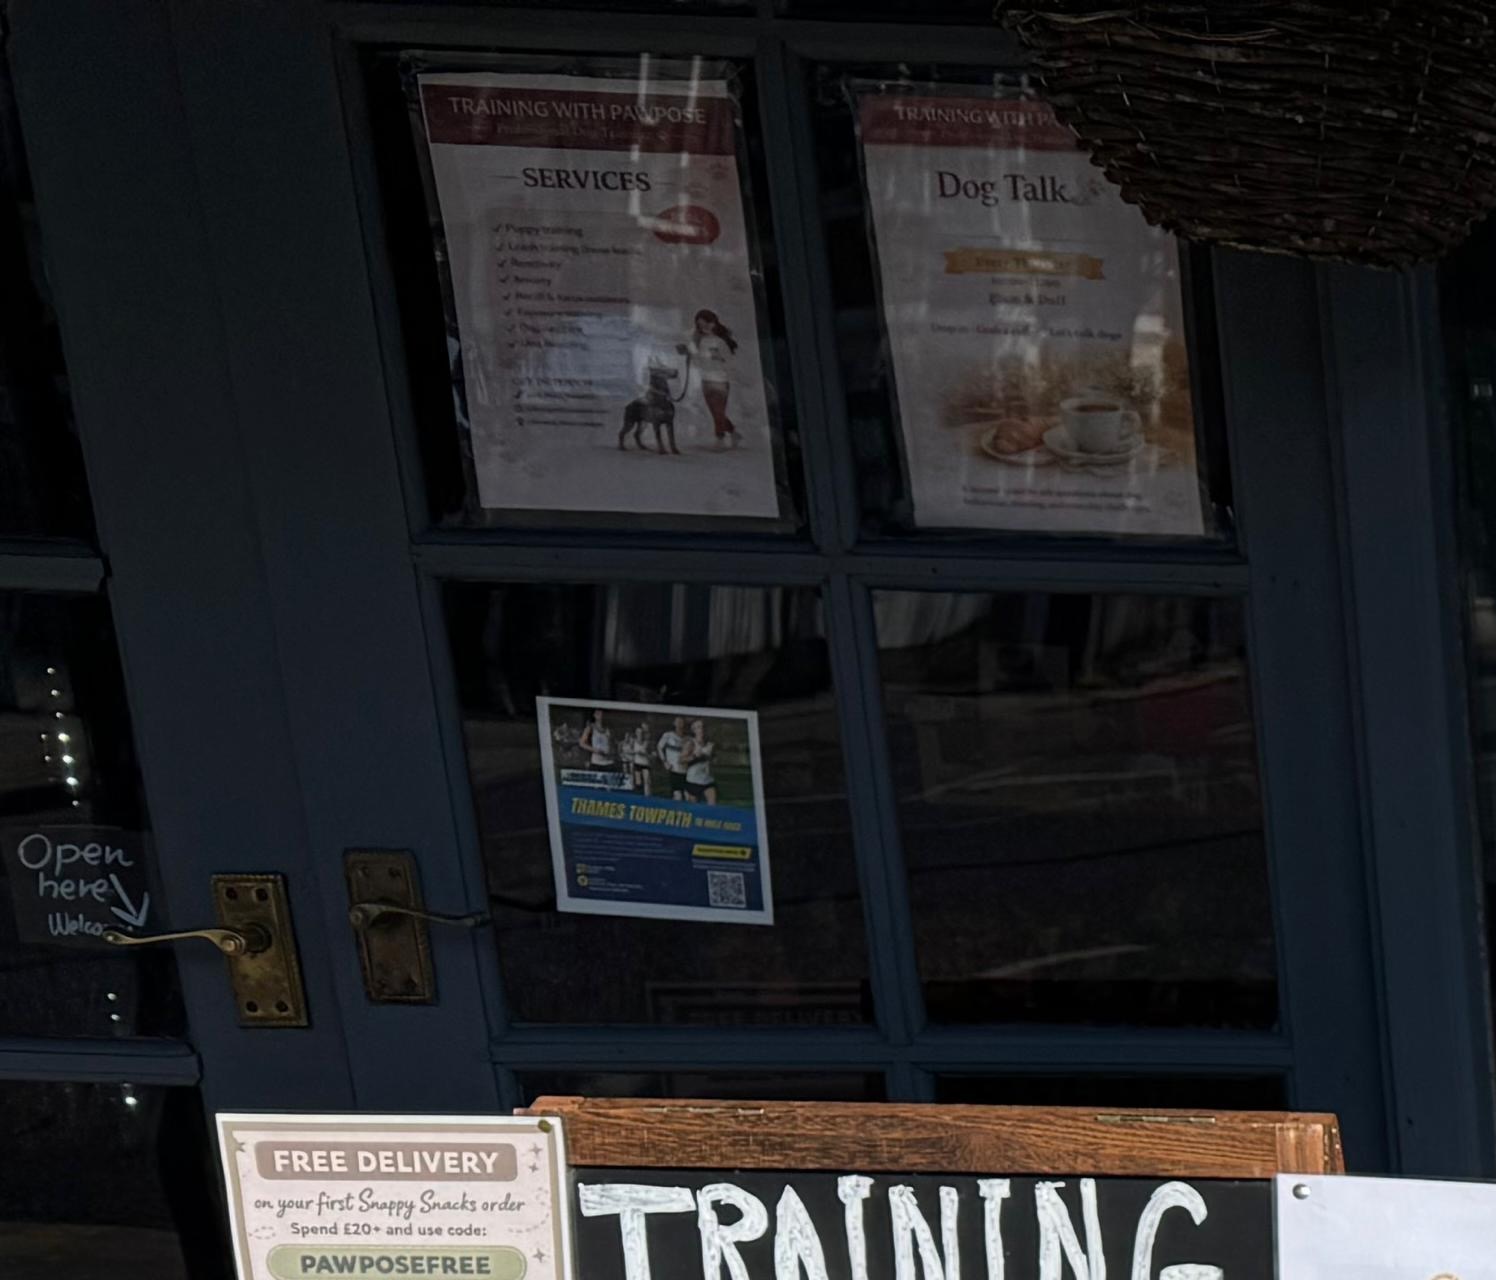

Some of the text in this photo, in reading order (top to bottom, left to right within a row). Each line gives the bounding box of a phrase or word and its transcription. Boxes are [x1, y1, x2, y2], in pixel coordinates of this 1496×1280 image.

[448, 96, 707, 125] TRAINING WITH PAWPOSE
[895, 104, 986, 125] TRAINING
[522, 167, 652, 192] SERVICES
[936, 169, 1070, 207] Dog Talk
[571, 797, 626, 820] THAMES
[630, 804, 694, 828] TOWPATH
[17, 833, 134, 877] Open
[38, 871, 110, 903] here
[273, 1150, 499, 1174] FREE DELIVERY
[254, 1187, 526, 1220] on your first Snappy Snacks order
[290, 1222, 487, 1238] Spend £20+ and use code:
[301, 1255, 491, 1275] PAWPOSEFREE
